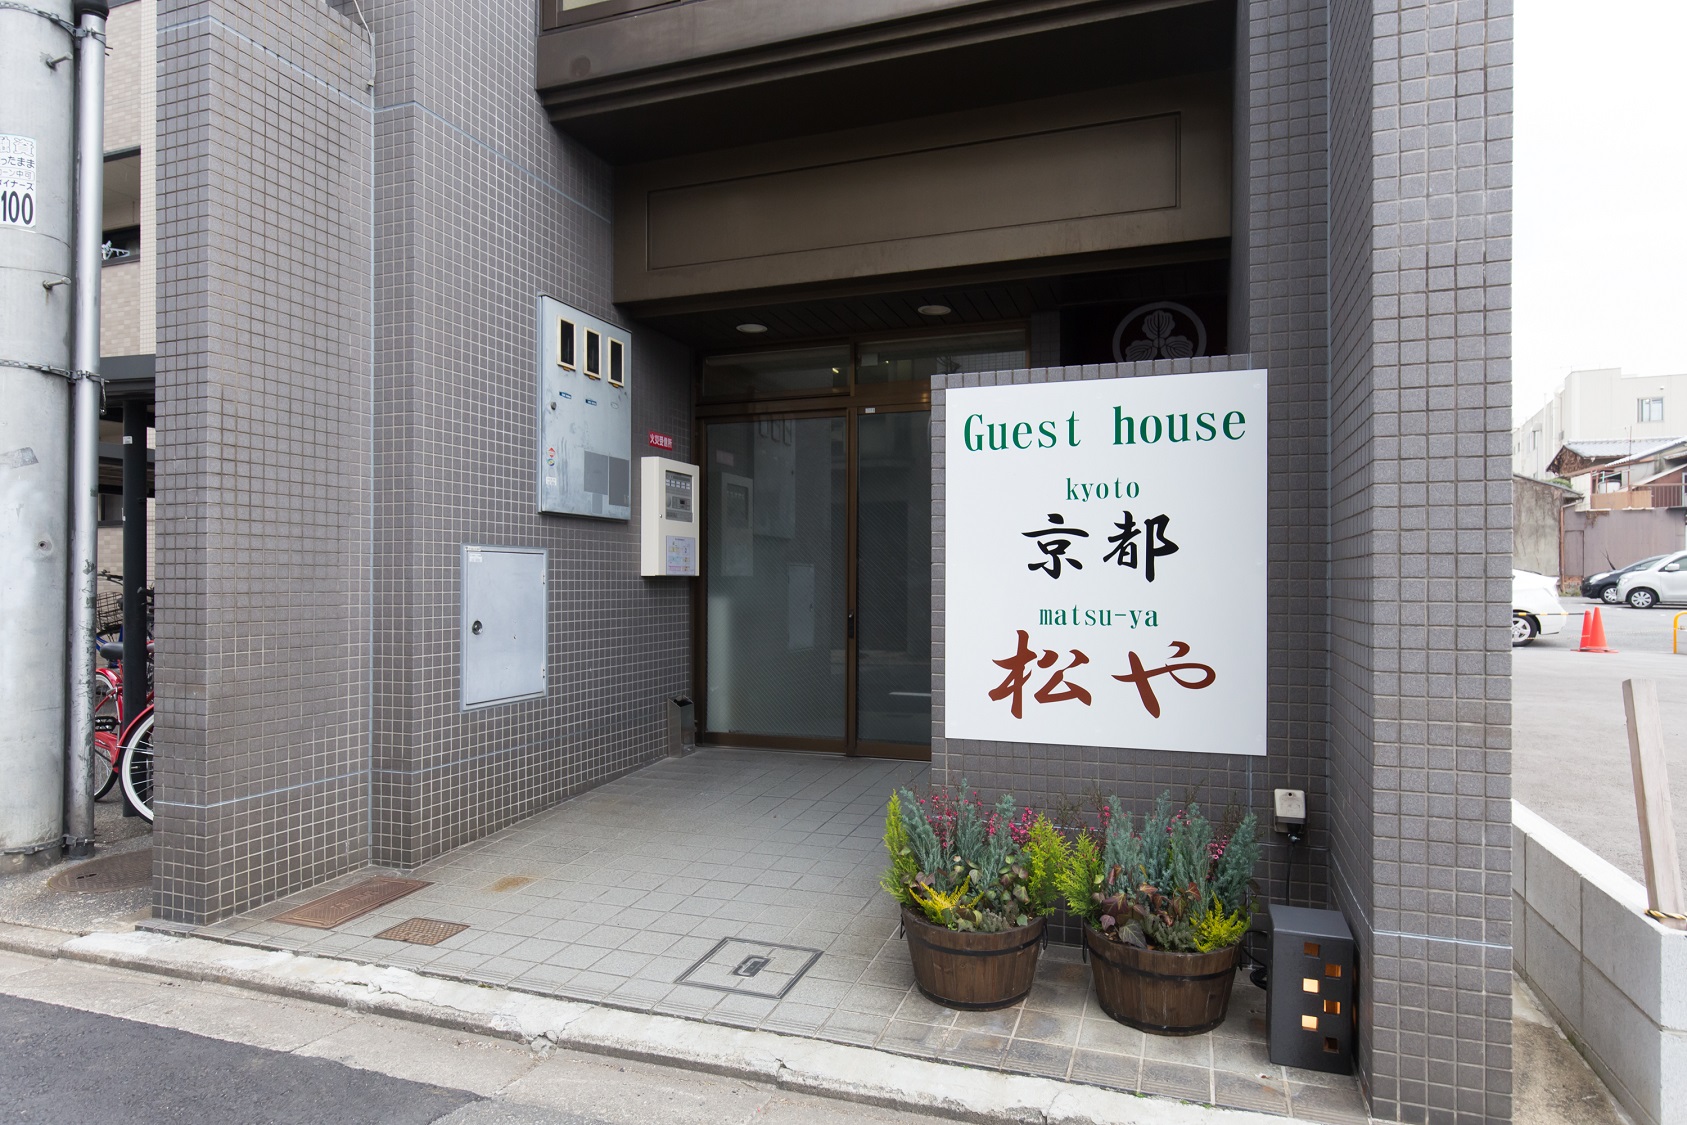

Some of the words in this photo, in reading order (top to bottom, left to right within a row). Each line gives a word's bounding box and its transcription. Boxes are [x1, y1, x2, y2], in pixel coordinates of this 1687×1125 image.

[0, 156, 35, 169] ったまま
[0, 168, 32, 179] ーン中可
[1, 190, 34, 225] 100
[963, 410, 1082, 452] Guest
[1112, 405, 1246, 446] house
[1066, 477, 1139, 503] kyoto
[1021, 510, 1180, 583] 京都
[1039, 605, 1159, 630] matsu-ya
[987, 629, 1217, 720] 松や
